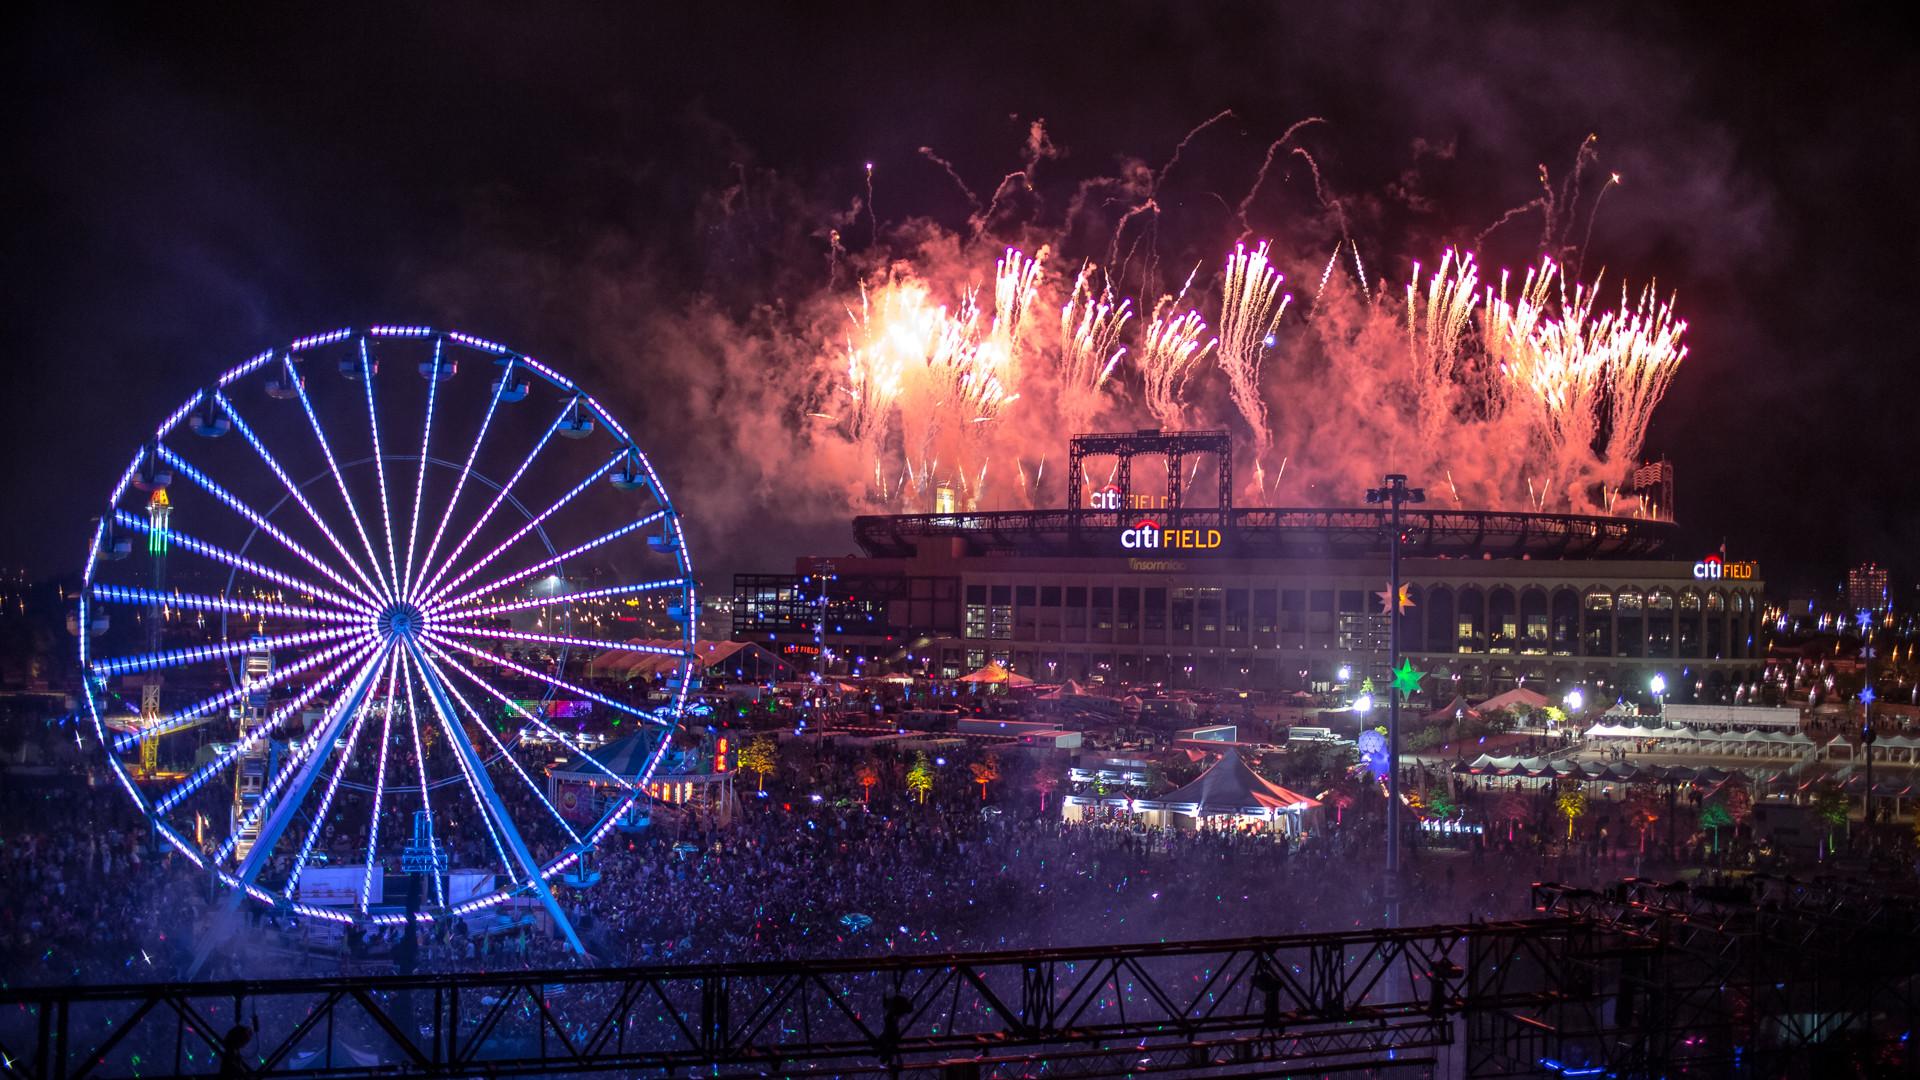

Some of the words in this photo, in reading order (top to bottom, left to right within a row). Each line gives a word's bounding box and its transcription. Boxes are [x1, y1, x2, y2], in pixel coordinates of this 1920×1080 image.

[1121, 524, 1159, 548] citi
[1163, 529, 1221, 548] FIELD
[1693, 560, 1721, 578] citi
[1723, 564, 1752, 578] FIELD
[800, 645, 819, 655] FIELD
